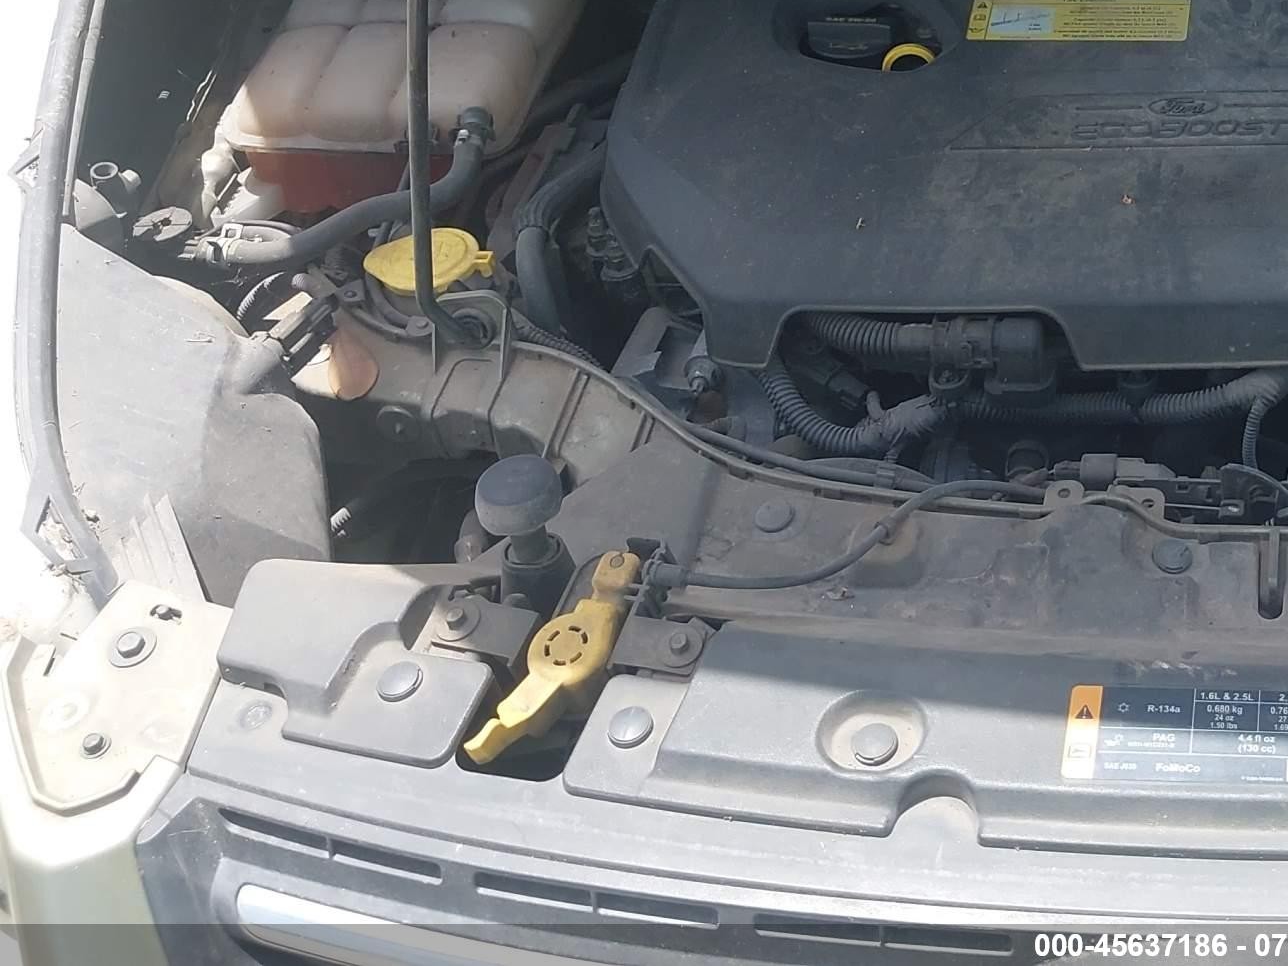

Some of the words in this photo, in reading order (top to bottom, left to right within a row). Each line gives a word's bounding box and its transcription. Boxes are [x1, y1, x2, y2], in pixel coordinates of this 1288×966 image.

[1160, 98, 1208, 116] Ford
[1200, 692, 1221, 700] 1.6L
[1223, 692, 1231, 700] &
[1233, 693, 1254, 701] 2.5L
[1147, 704, 1181, 713] R-134a
[1206, 704, 1230, 713] 0.680
[1232, 705, 1243, 715] kg
[1152, 733, 1176, 742] PAG
[1154, 762, 1201, 772] FoMoCo
